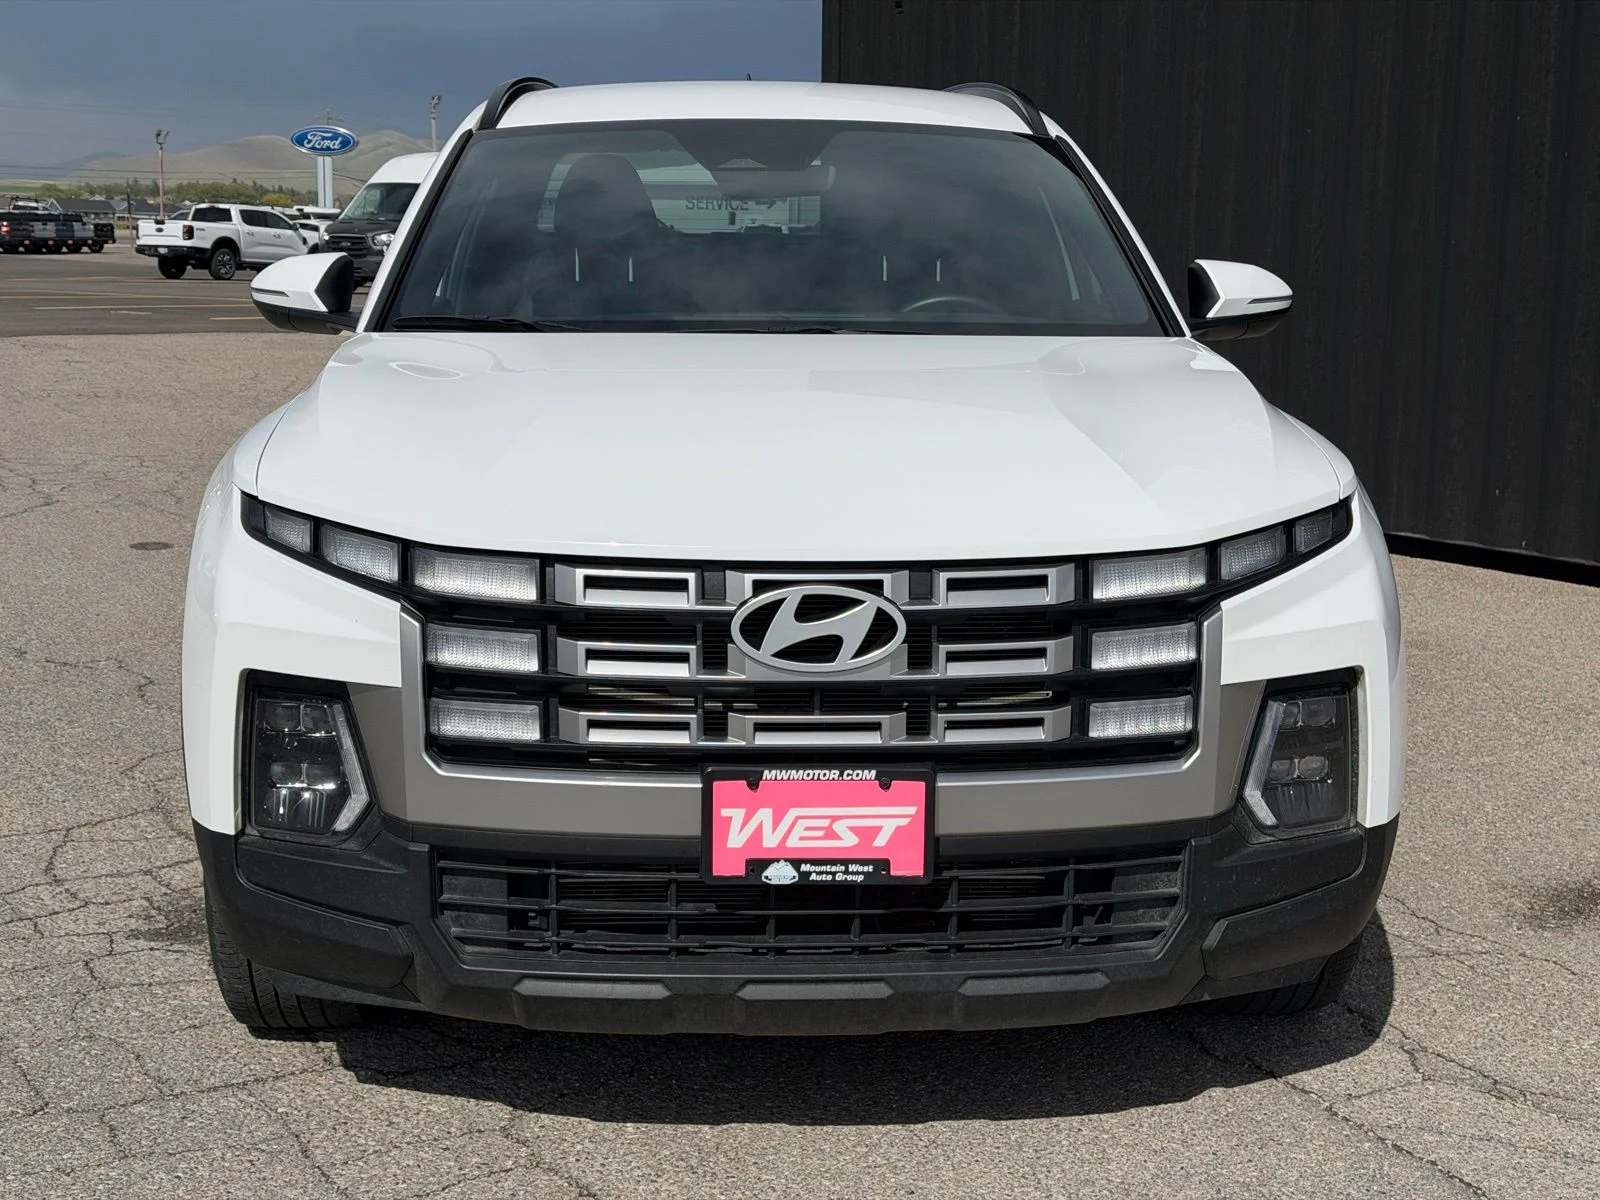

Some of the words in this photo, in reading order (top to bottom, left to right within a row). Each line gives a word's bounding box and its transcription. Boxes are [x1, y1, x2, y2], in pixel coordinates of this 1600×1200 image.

[304, 132, 341, 149] Ford
[685, 195, 749, 211] SERVICE
[762, 770, 876, 781] MWMOTOR.COM
[720, 806, 917, 848] WEST
[800, 863, 845, 872] Mountain
[848, 864, 874, 872] West
[809, 873, 833, 881] Auto
[835, 873, 864, 882] Group
